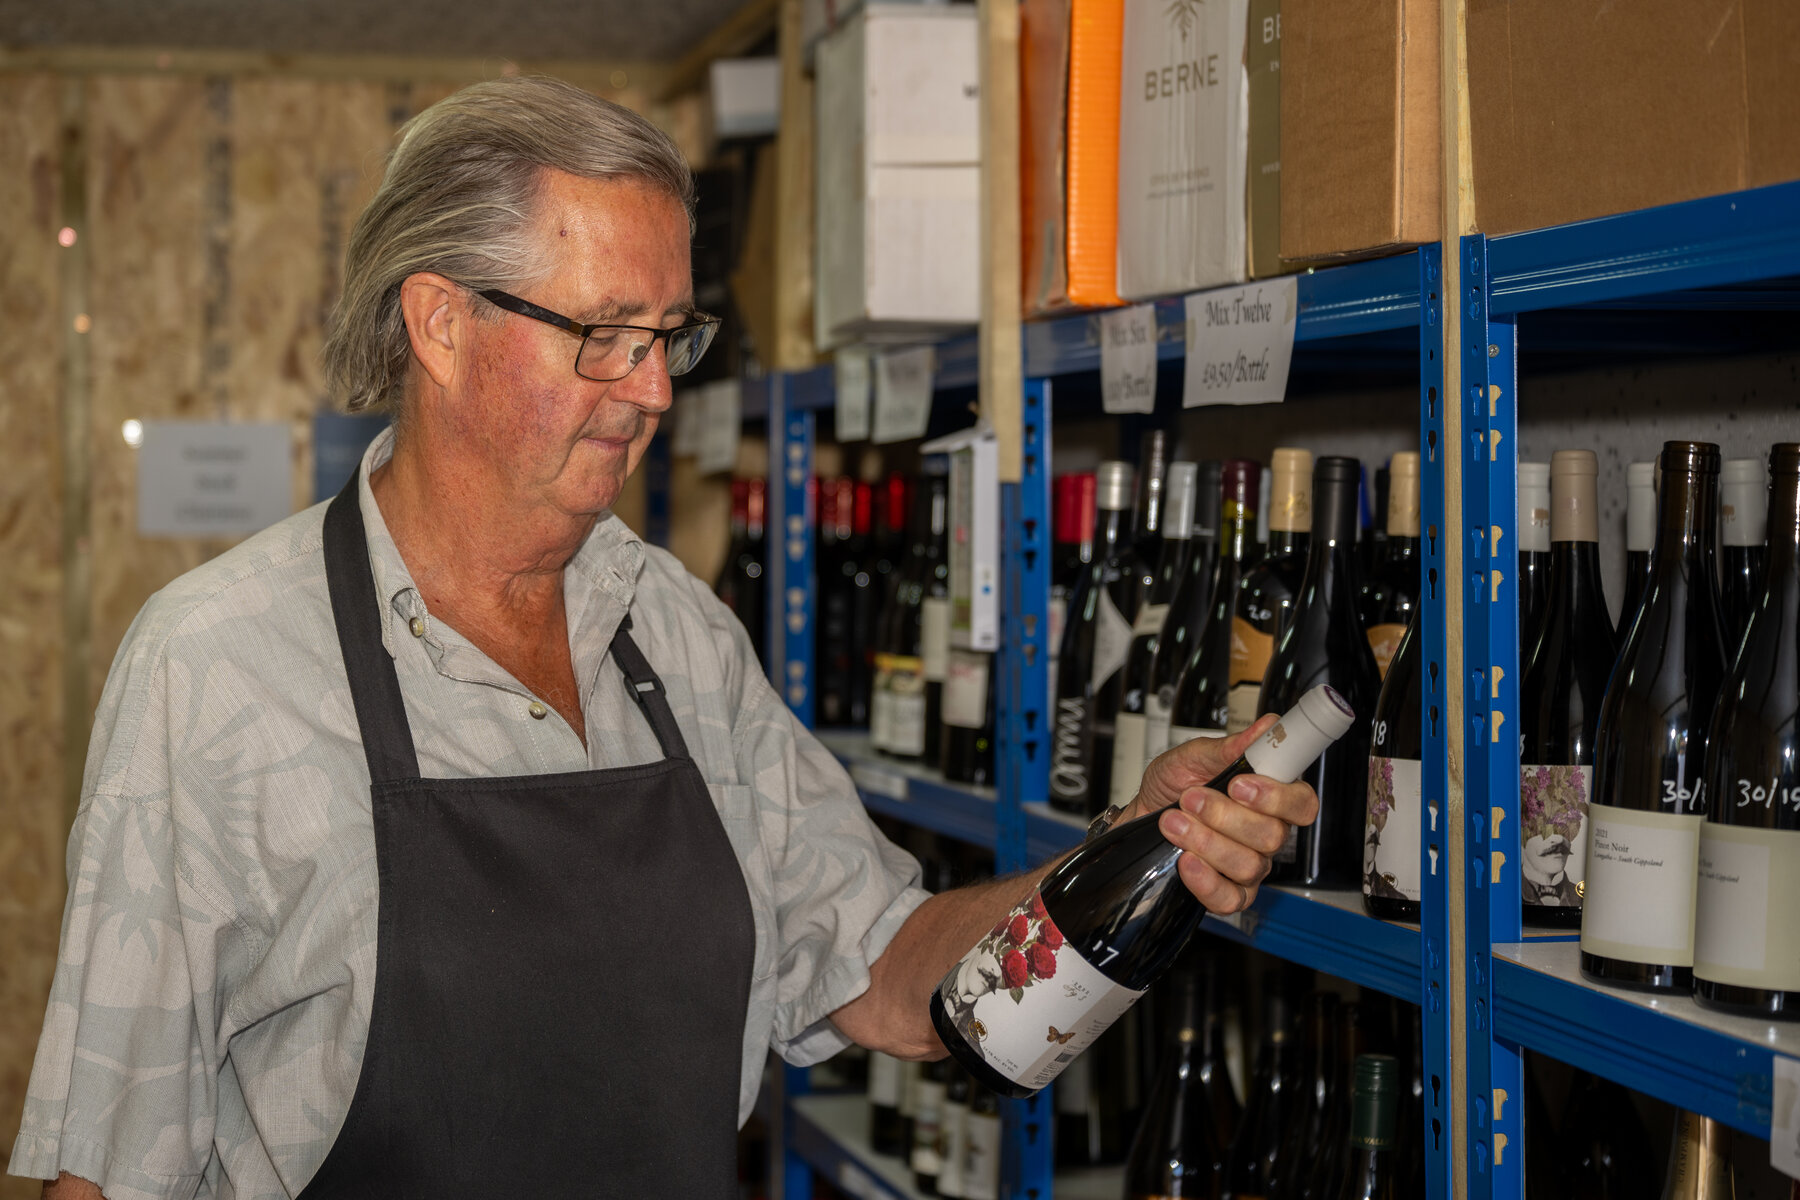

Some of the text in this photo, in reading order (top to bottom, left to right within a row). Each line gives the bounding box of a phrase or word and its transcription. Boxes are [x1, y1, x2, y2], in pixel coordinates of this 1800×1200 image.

[1145, 54, 1219, 102] BERNE
[1207, 288, 1272, 327] Mix Twelve
[1202, 347, 1270, 390] £9.50/Bottle
[1248, 604, 1272, 620] 20
[1594, 839, 1630, 854] Pinot Noir
[1633, 856, 1664, 869] Gippsland
[1678, 1120, 1691, 1184] CHAMPAGNE
